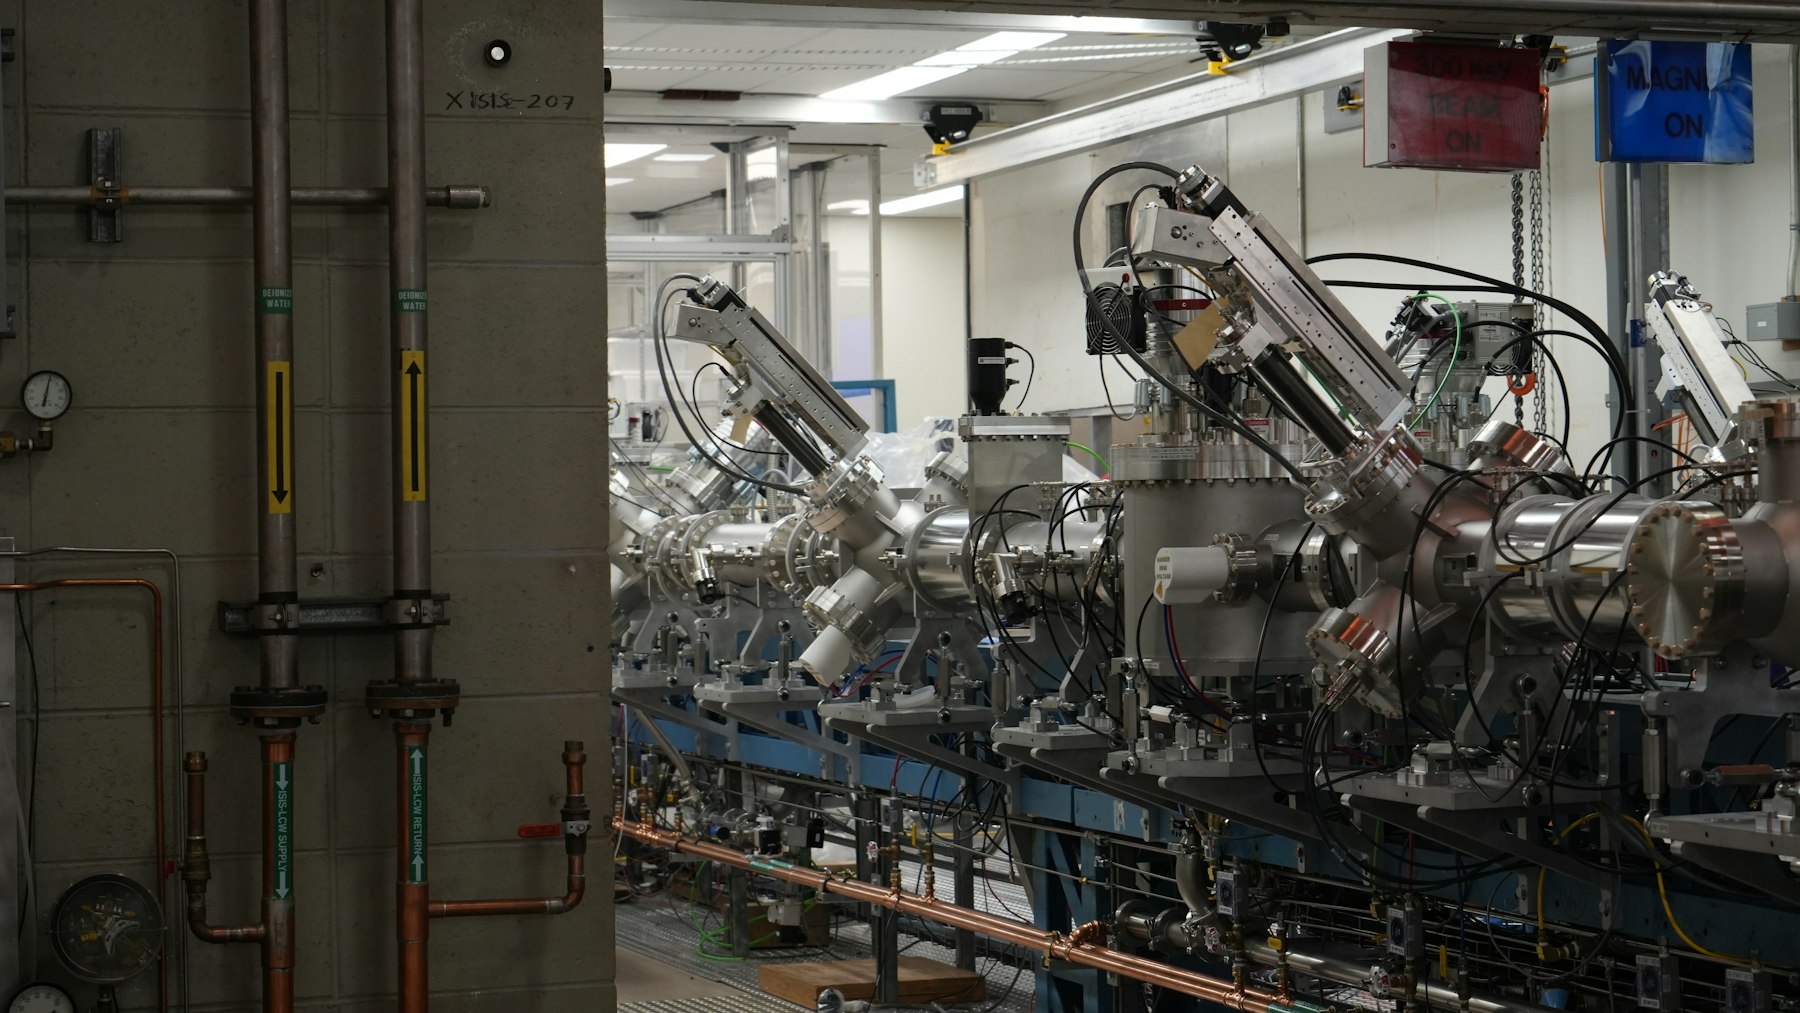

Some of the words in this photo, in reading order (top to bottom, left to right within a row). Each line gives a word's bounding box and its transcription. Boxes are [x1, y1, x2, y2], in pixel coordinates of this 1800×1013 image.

[1446, 129, 1482, 153] ON
[1664, 112, 1704, 139] ON
[278, 790, 287, 833] ISIS-LCW
[413, 774, 422, 815] ISIS-LCW
[278, 834, 287, 872] SUPPLY
[413, 817, 422, 855] RETURN
